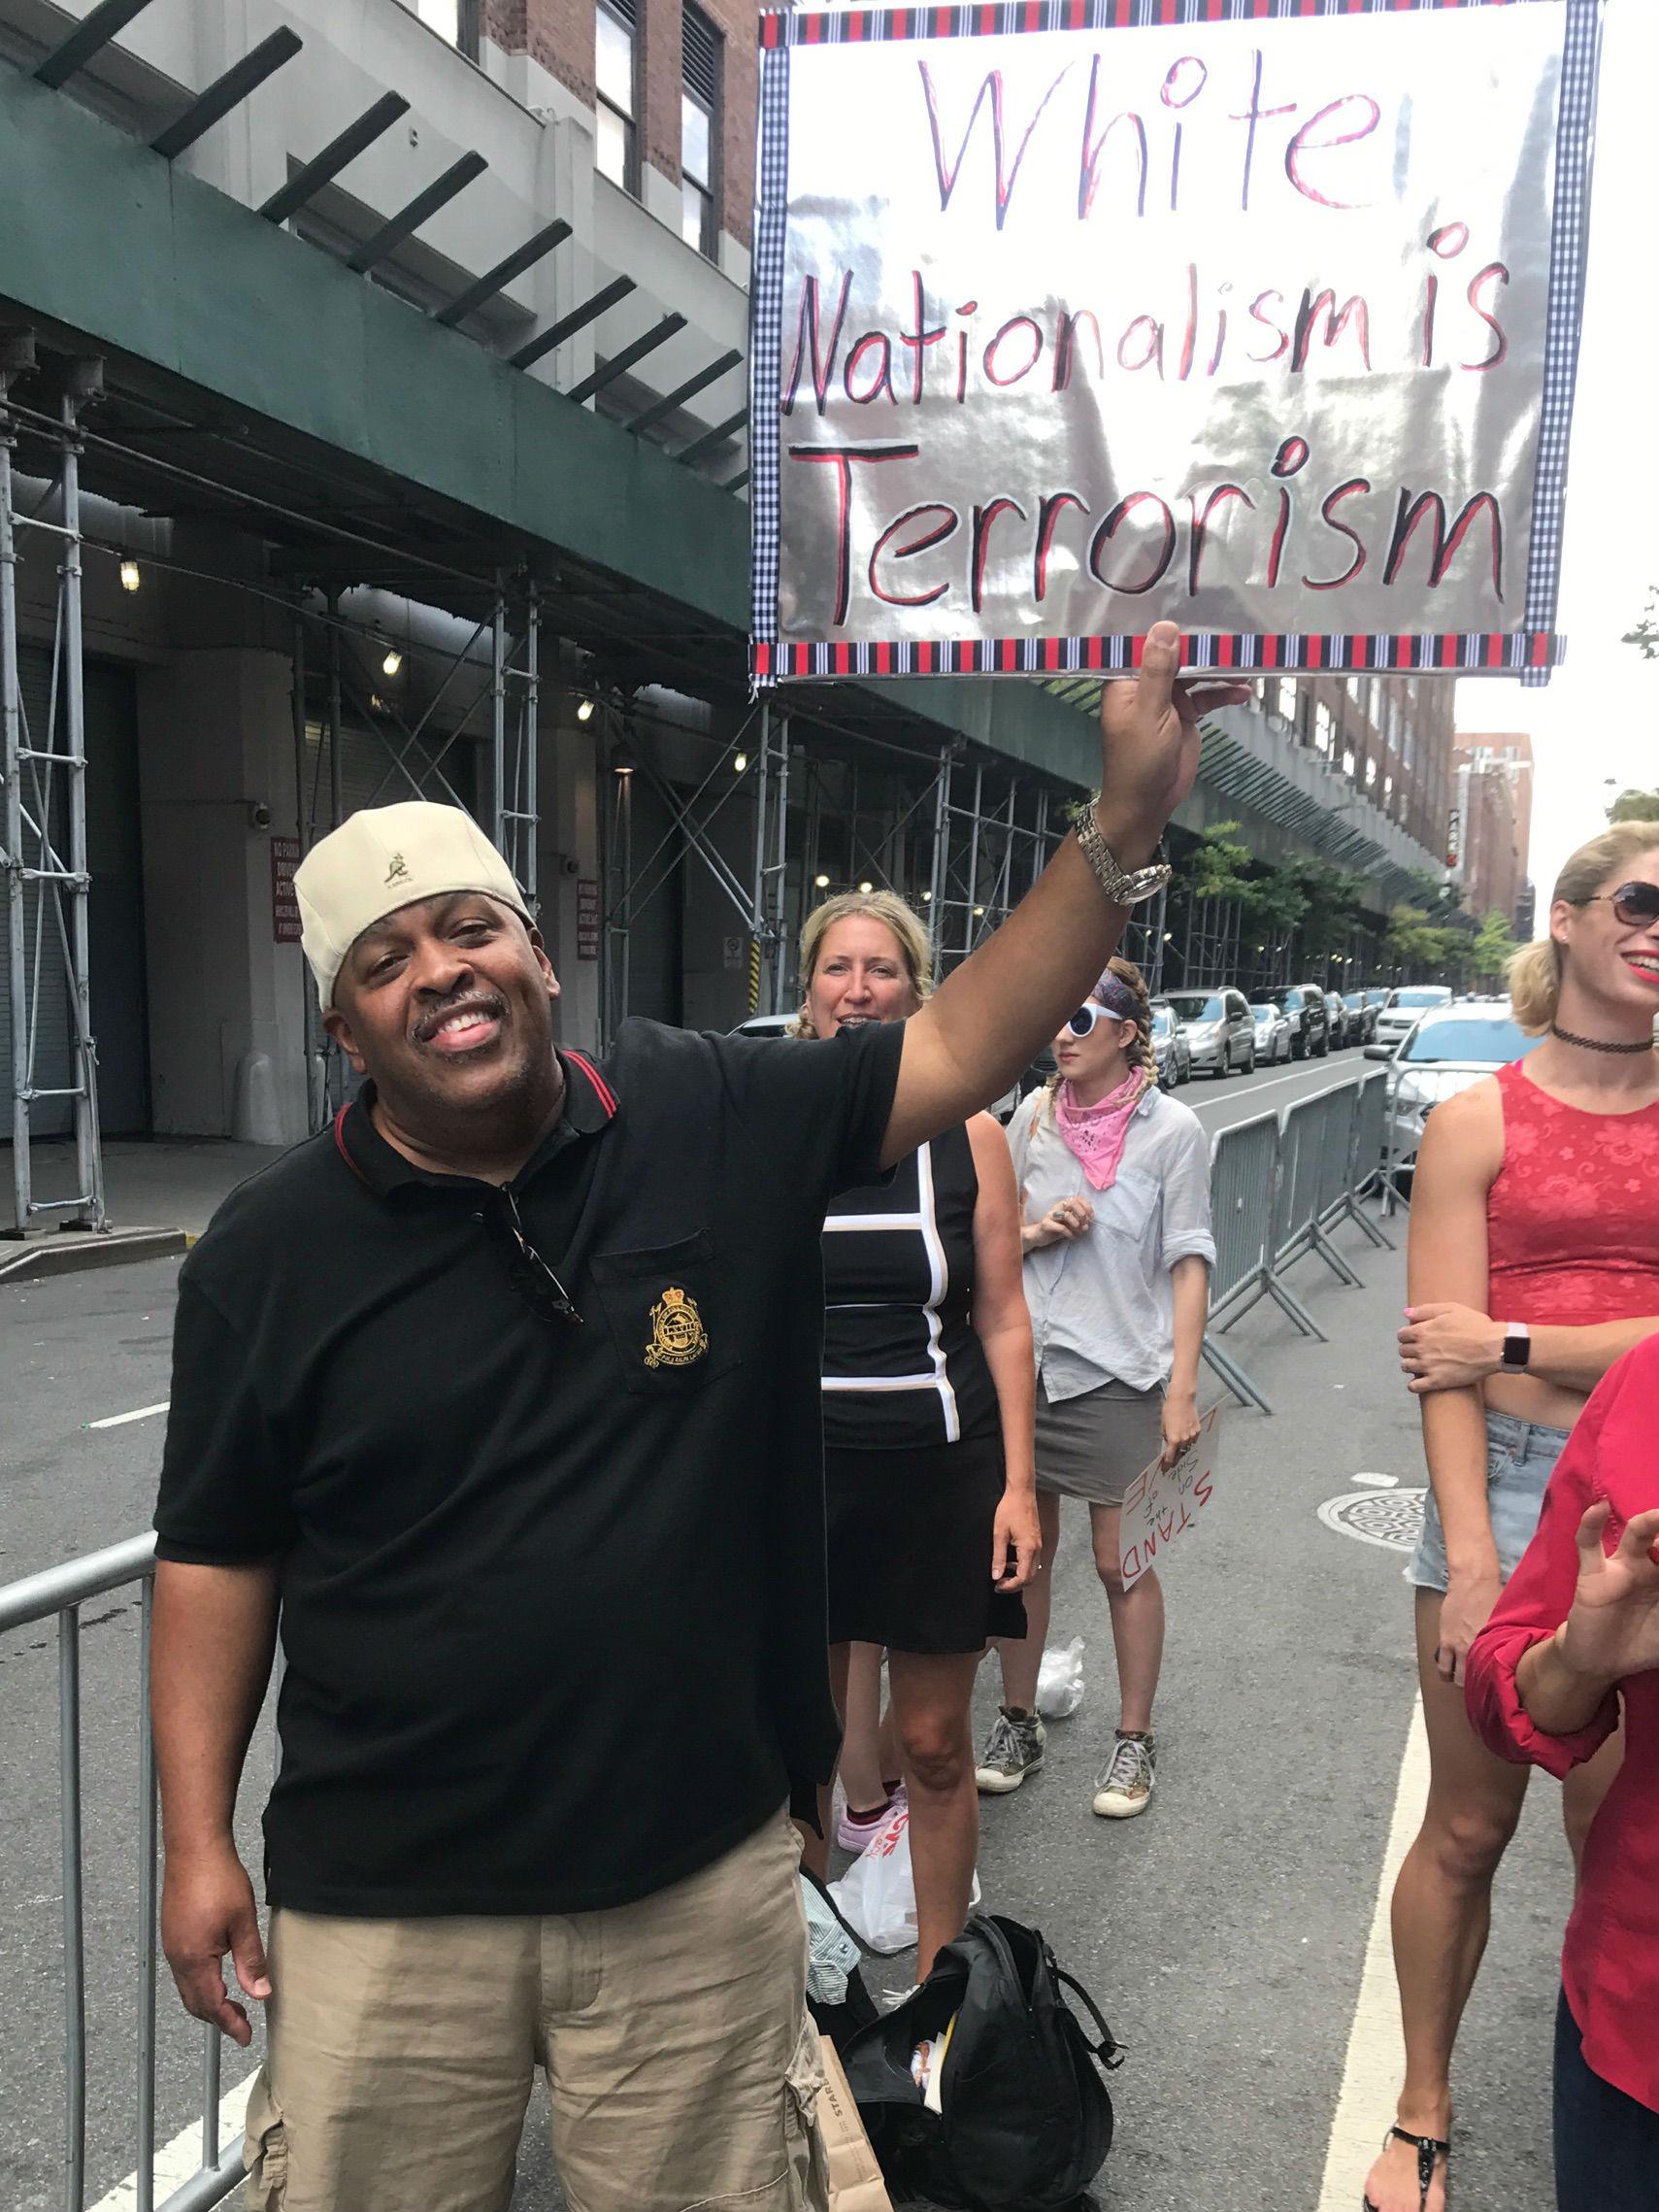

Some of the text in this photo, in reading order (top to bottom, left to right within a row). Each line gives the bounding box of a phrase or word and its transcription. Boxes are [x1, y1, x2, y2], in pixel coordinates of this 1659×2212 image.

[918, 49, 1380, 231] White
[780, 221, 1510, 418] Nationalism is
[788, 434, 1506, 627] Terrorism
[1122, 1470, 1213, 1579] STAND
[1146, 1505, 1169, 1526] the
